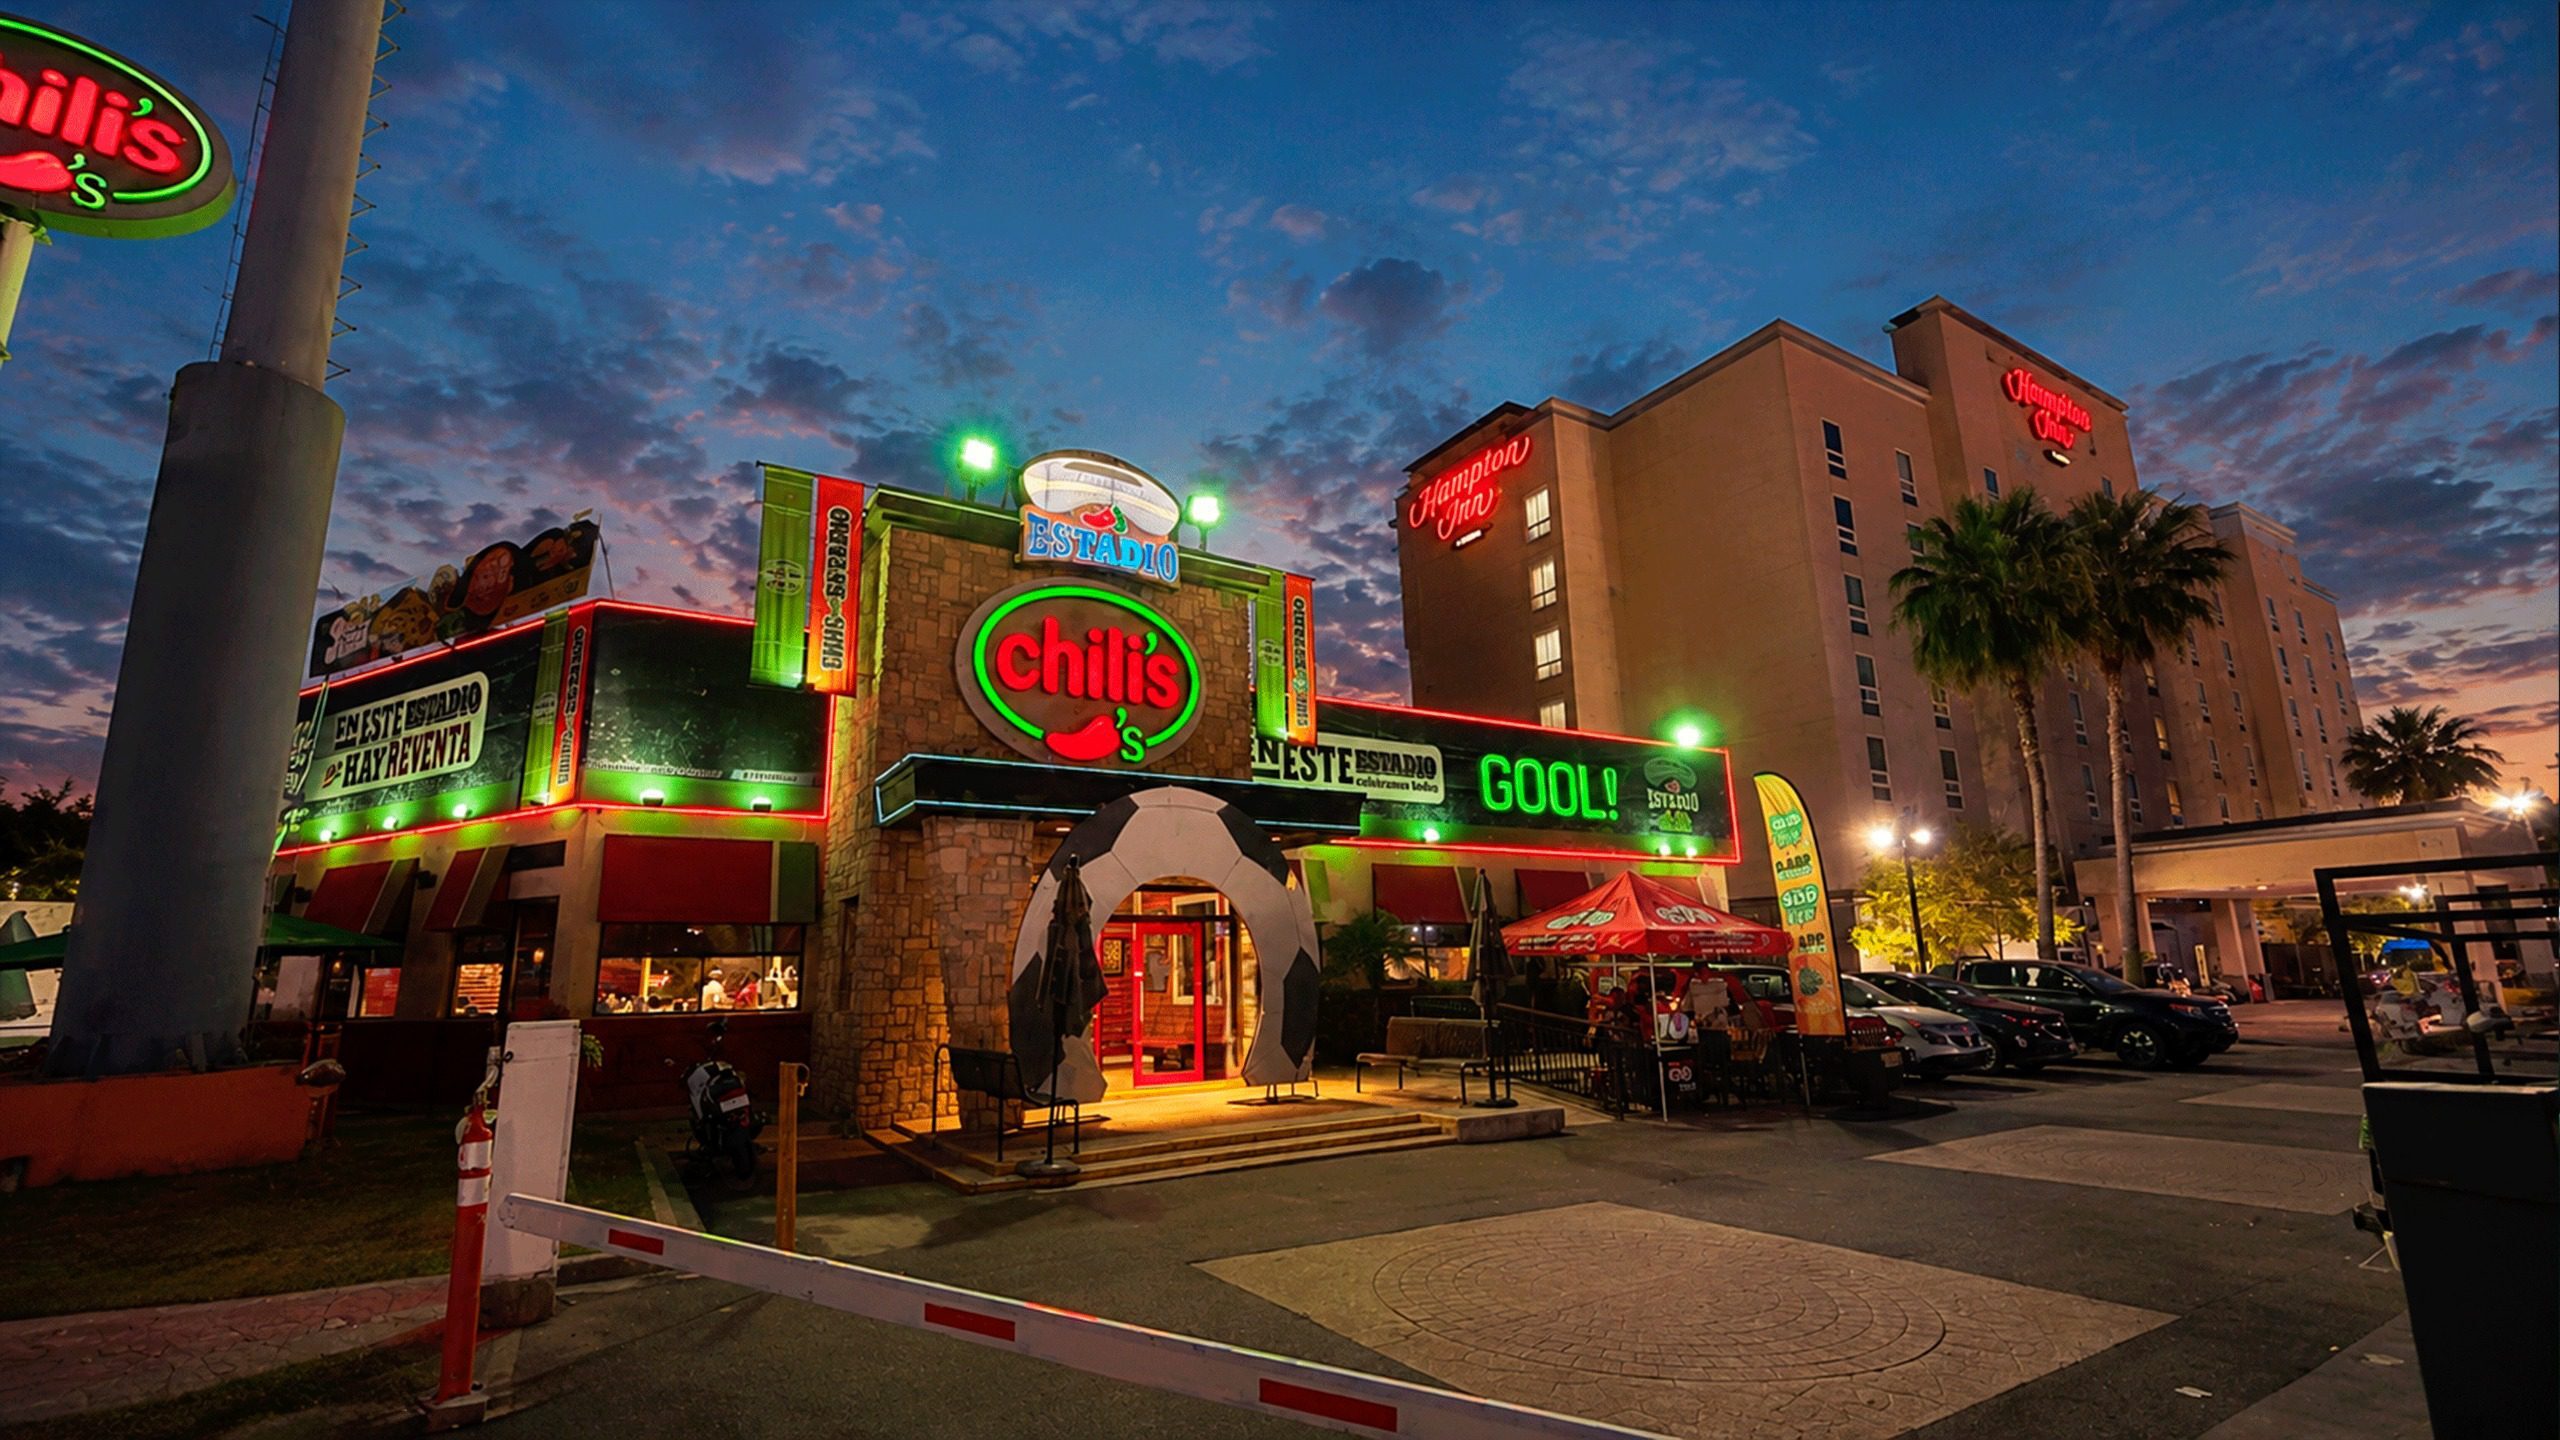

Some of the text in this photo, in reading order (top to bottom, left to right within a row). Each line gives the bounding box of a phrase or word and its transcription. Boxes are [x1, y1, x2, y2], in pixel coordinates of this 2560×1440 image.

[0, 51, 186, 174] hili's
[2006, 368, 2092, 432] Hampton
[2034, 410, 2074, 449] Inn
[1409, 436, 1531, 528] Hampton
[1437, 488, 1494, 540] Inn
[1027, 511, 1179, 583] ESTADIO
[996, 614, 1180, 710] chili's
[336, 681, 482, 745] EN ESTE ESTADIO
[342, 747, 387, 788] HAY
[385, 721, 470, 779] REVENTA
[1283, 743, 1354, 785] ESTE
[1355, 749, 1437, 780] ESTADIO
[1481, 753, 1618, 821] GOOL!
